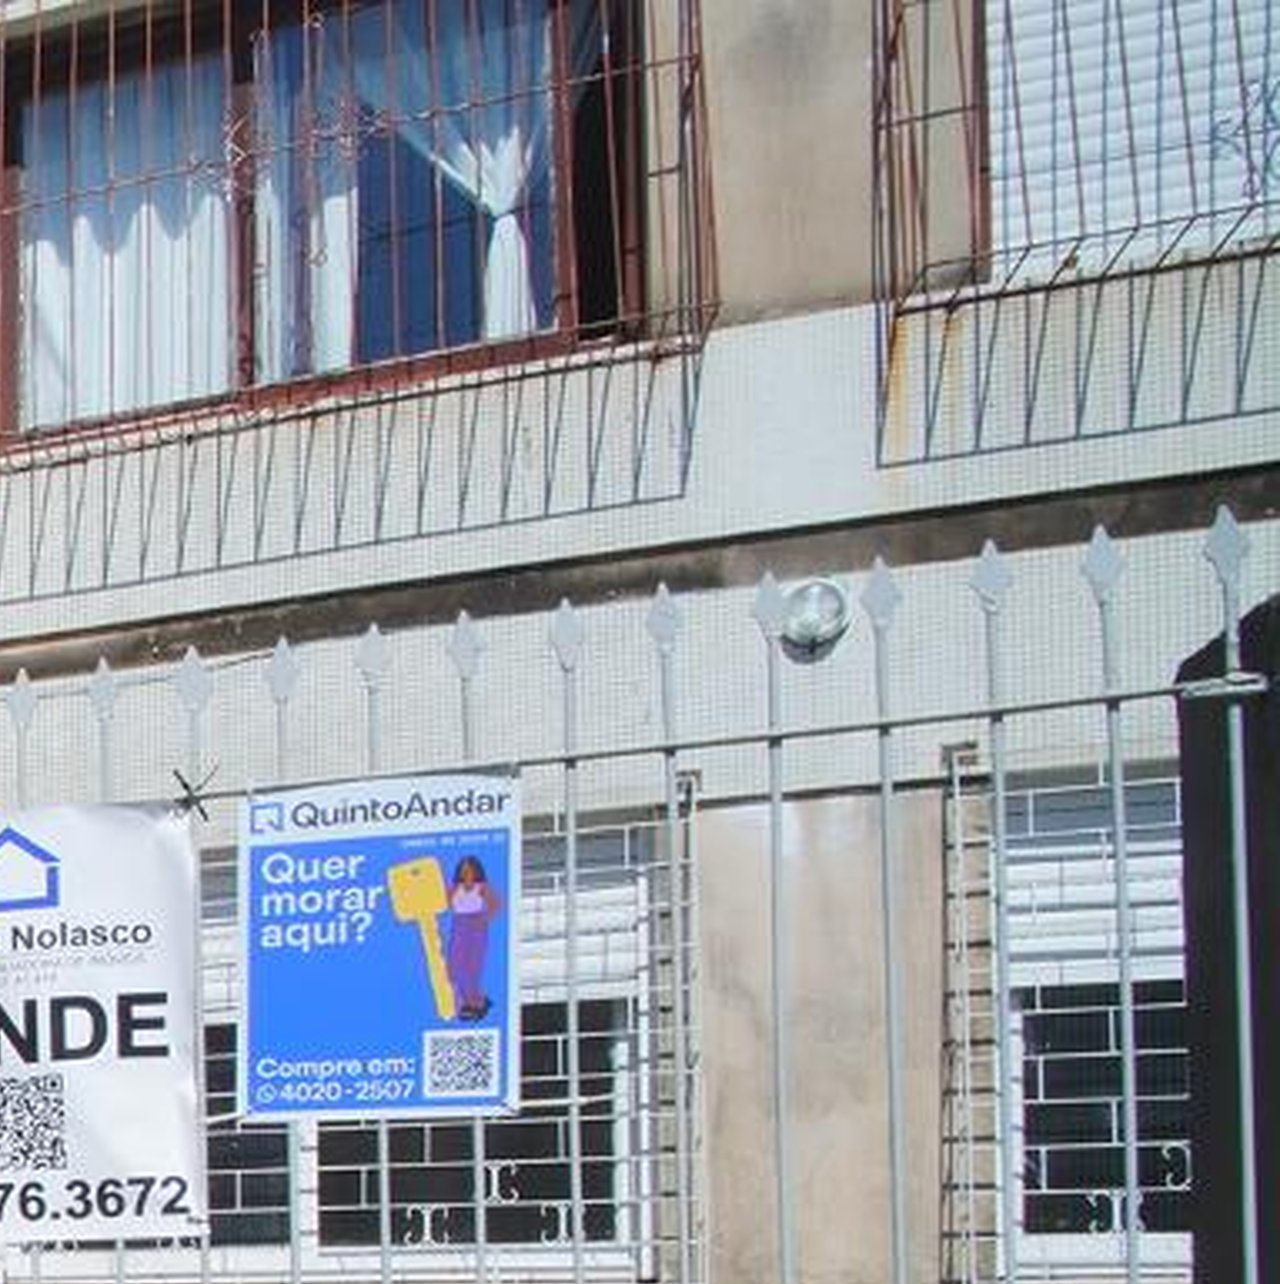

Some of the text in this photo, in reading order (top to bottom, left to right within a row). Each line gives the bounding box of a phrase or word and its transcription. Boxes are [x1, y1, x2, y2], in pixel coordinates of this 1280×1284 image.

[291, 790, 510, 828] QuintoAndar
[260, 853, 366, 885] Quer
[261, 886, 384, 917] morar
[10, 922, 153, 952] Nolasco
[259, 911, 372, 953] aqui?
[256, 1056, 416, 1081] Compre em:
